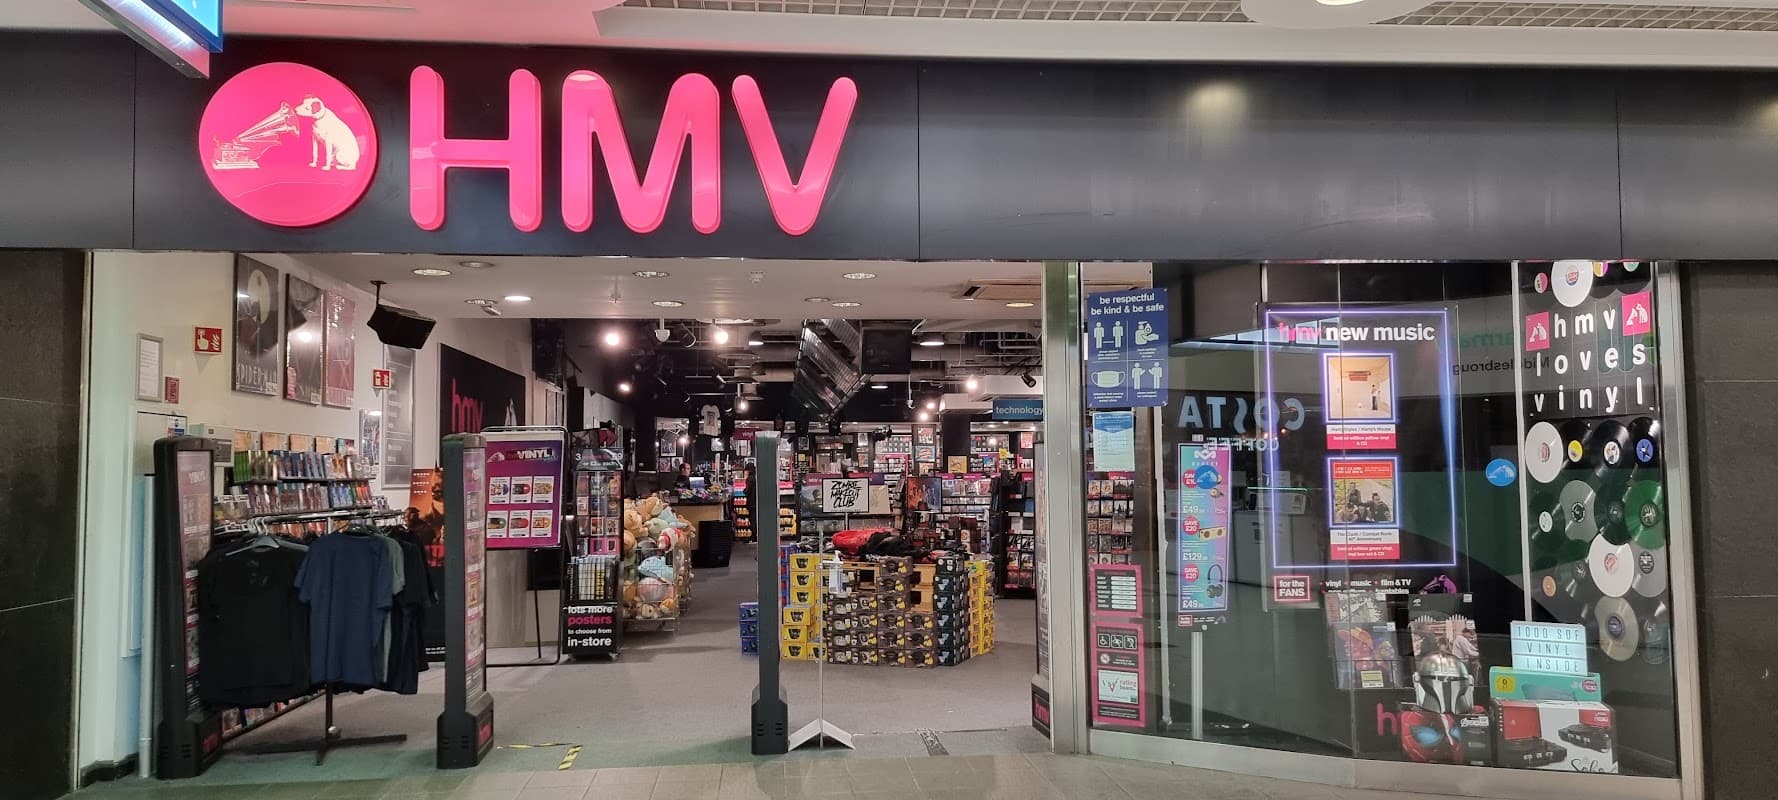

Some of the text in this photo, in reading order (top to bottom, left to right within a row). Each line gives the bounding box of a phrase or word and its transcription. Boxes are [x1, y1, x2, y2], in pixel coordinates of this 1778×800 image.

[408, 65, 857, 236] HMV
[1099, 293, 1155, 304] be respectful
[1091, 303, 1164, 315] be kind & be safe
[1554, 308, 1616, 339] hmv
[1278, 321, 1435, 342] hmv new music
[1536, 343, 1646, 377] loves
[1534, 377, 1643, 413] vinyl
[452, 377, 484, 433] hmv
[996, 406, 1044, 416] technology
[517, 449, 550, 460] VINYL
[1279, 579, 1305, 587] for the
[1325, 579, 1342, 588] vinyl
[1350, 579, 1372, 587] music
[1380, 579, 1394, 587] film
[1279, 588, 1305, 597] FANS
[567, 606, 613, 615] lots more
[567, 616, 612, 627] posters
[567, 636, 612, 647] in-store
[1526, 642, 1570, 656] VINYL
[1527, 658, 1579, 672] INSIDE
